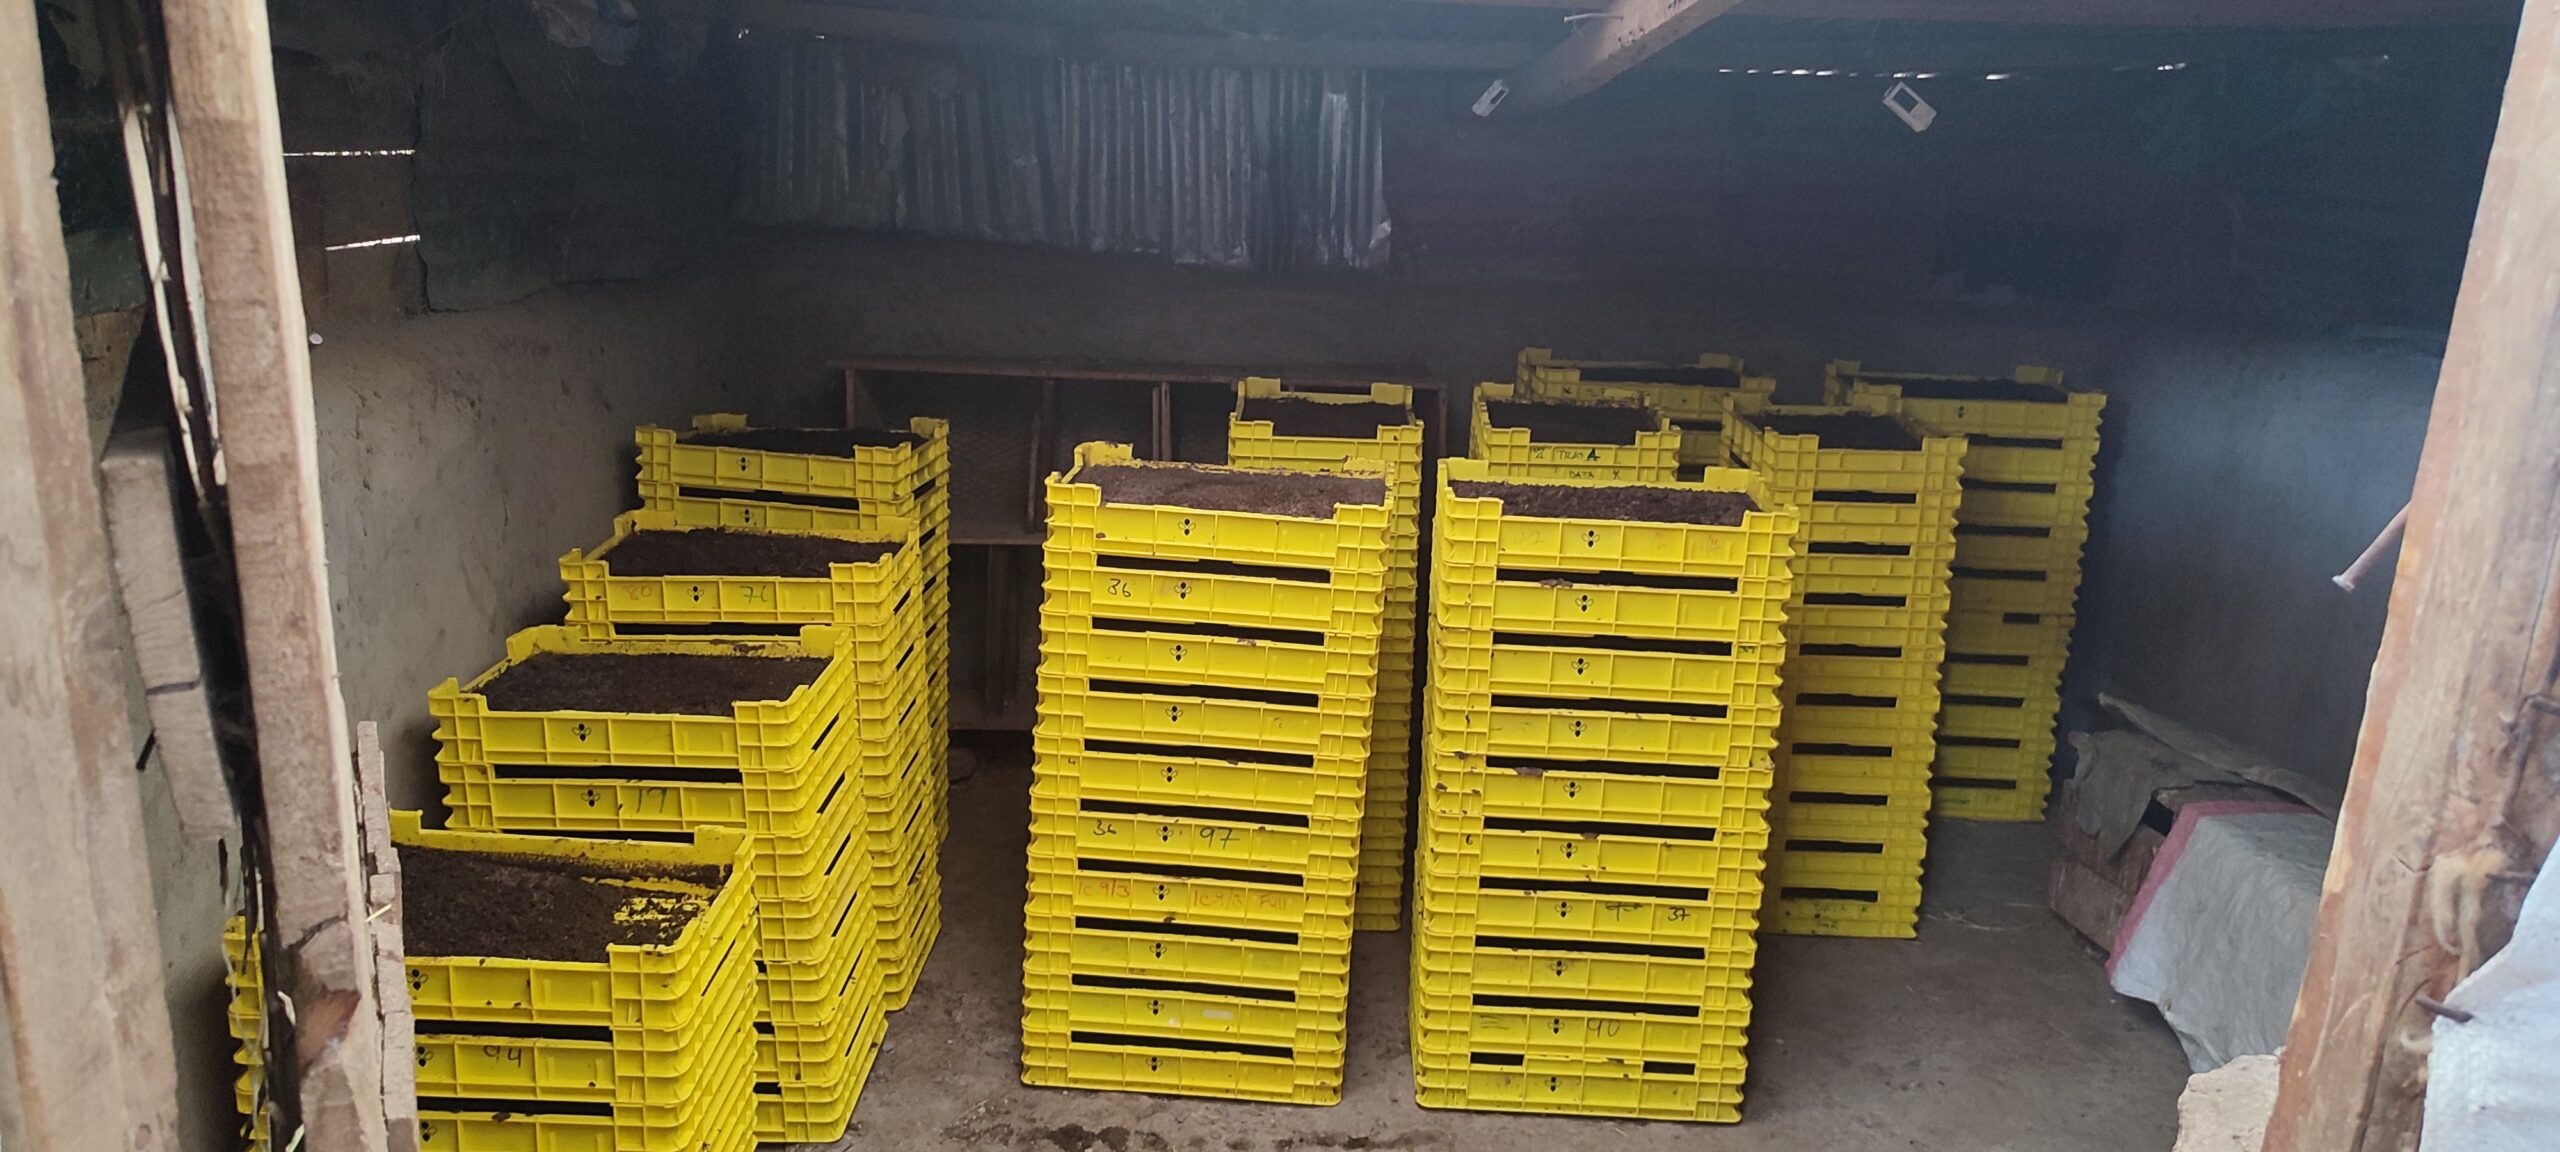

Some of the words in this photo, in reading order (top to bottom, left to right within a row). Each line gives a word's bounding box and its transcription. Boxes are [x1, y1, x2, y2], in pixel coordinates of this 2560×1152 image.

[1568, 470, 1596, 480] DATA
[1199, 826, 1241, 850] 97
[1667, 905, 1691, 922] 37
[483, 1045, 522, 1069] 94
